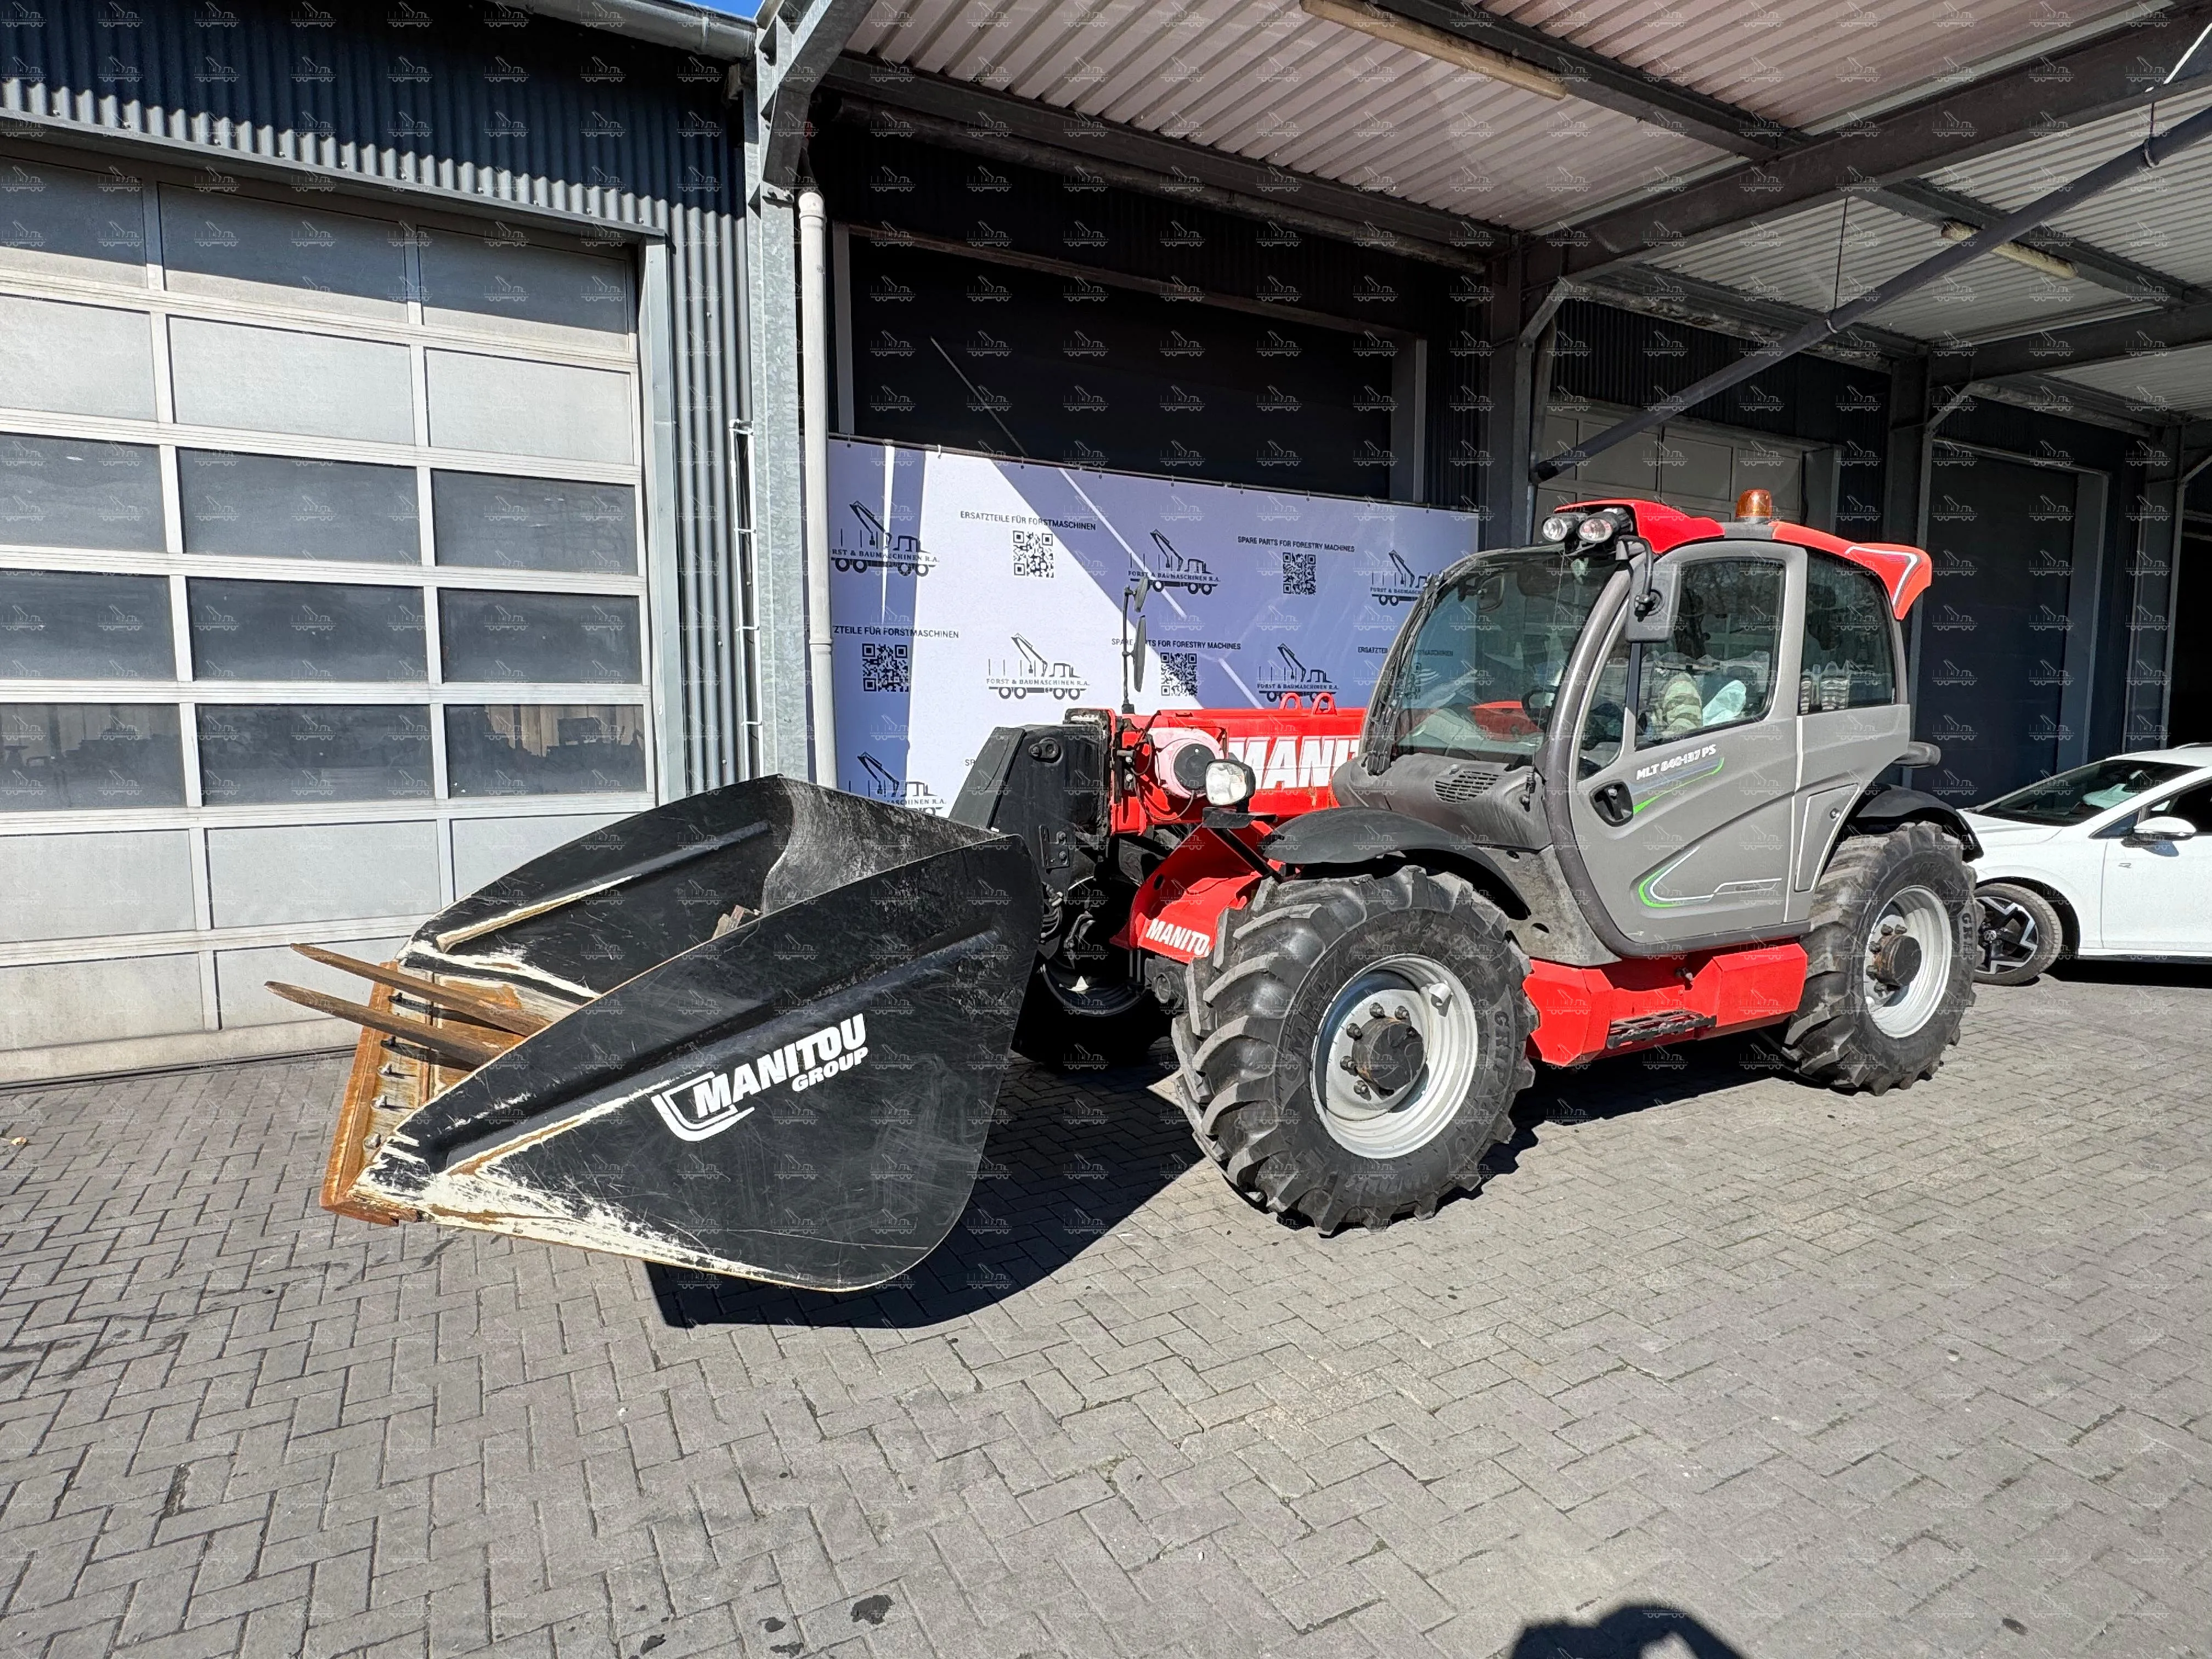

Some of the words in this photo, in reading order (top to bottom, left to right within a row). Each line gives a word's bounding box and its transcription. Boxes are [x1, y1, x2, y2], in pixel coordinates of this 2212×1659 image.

[960, 511, 1009, 523] ERSATZTEILE
[1012, 515, 1026, 524] FÜR
[1028, 517, 1096, 531] FORSTMASCHINEN
[1238, 536, 1257, 544] SPARE
[1259, 538, 1278, 546] PARTS
[1293, 541, 1323, 549] FORESTRY
[1324, 543, 1355, 552] MACHINES
[859, 550, 922, 561] BAUMASCHINEN
[1158, 573, 1207, 582] BAUMASCHINEN
[833, 626, 862, 635] ZTEILE
[864, 626, 882, 636] FÜR
[883, 627, 959, 639] FORSTMASCHINEN
[1172, 640, 1206, 648] FORESTRY
[1228, 735, 1361, 790] MANI
[1636, 763, 1660, 780] MLT
[1702, 744, 1717, 758] PS
[1145, 918, 1210, 957] MANITO
[692, 1013, 867, 1119] MANITOU
[791, 1047, 869, 1092] GROUP
